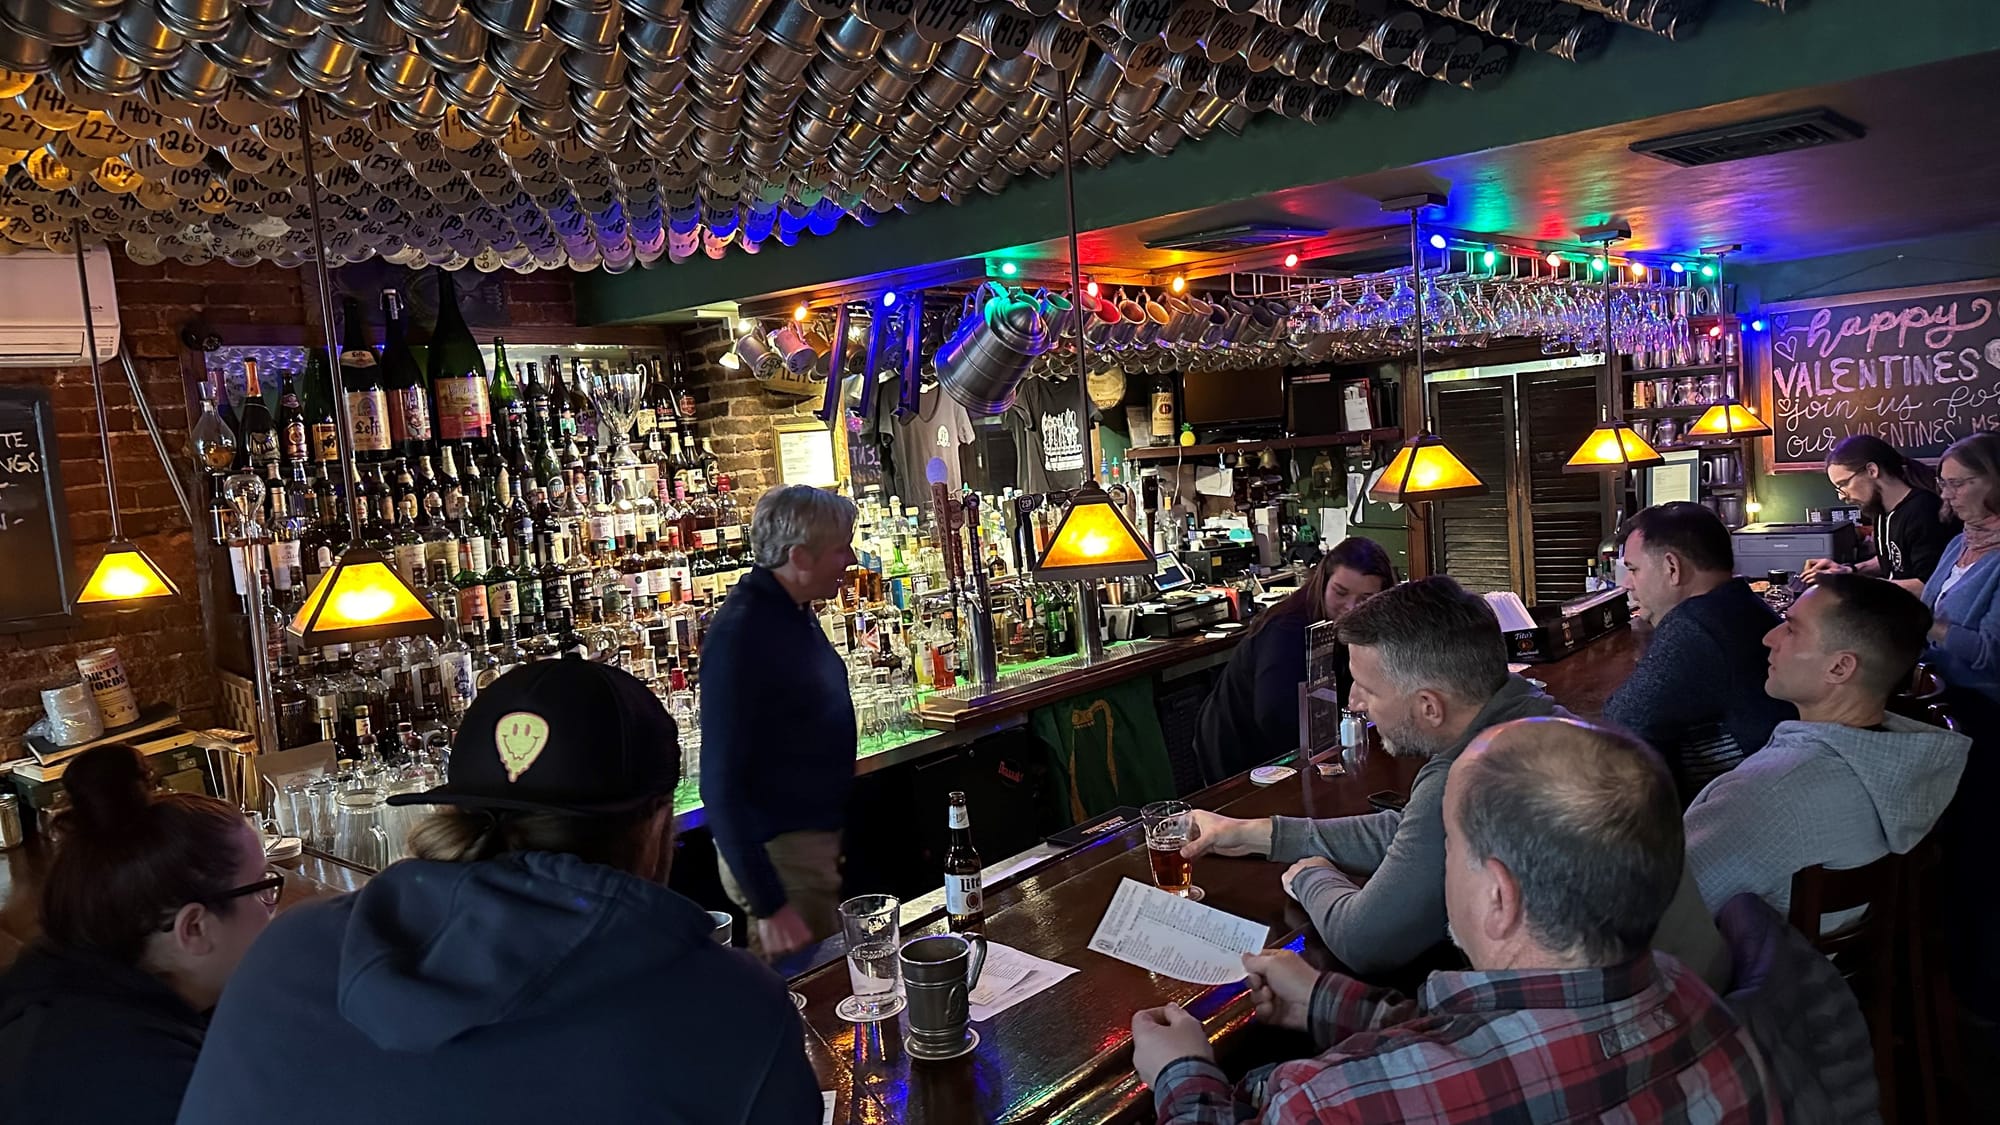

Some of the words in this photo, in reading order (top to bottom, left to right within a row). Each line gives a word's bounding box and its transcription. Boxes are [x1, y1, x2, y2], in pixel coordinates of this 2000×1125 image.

[265, 116, 301, 140] 138
[336, 126, 374, 152] 1386
[171, 167, 211, 186] 1099
[1781, 298, 1991, 357] happy
[1774, 348, 1981, 398] VALENTINES
[1778, 397, 1859, 432] join
[1865, 394, 1923, 420] us
[1786, 427, 1838, 458] our
[959, 877, 982, 893] Lite
